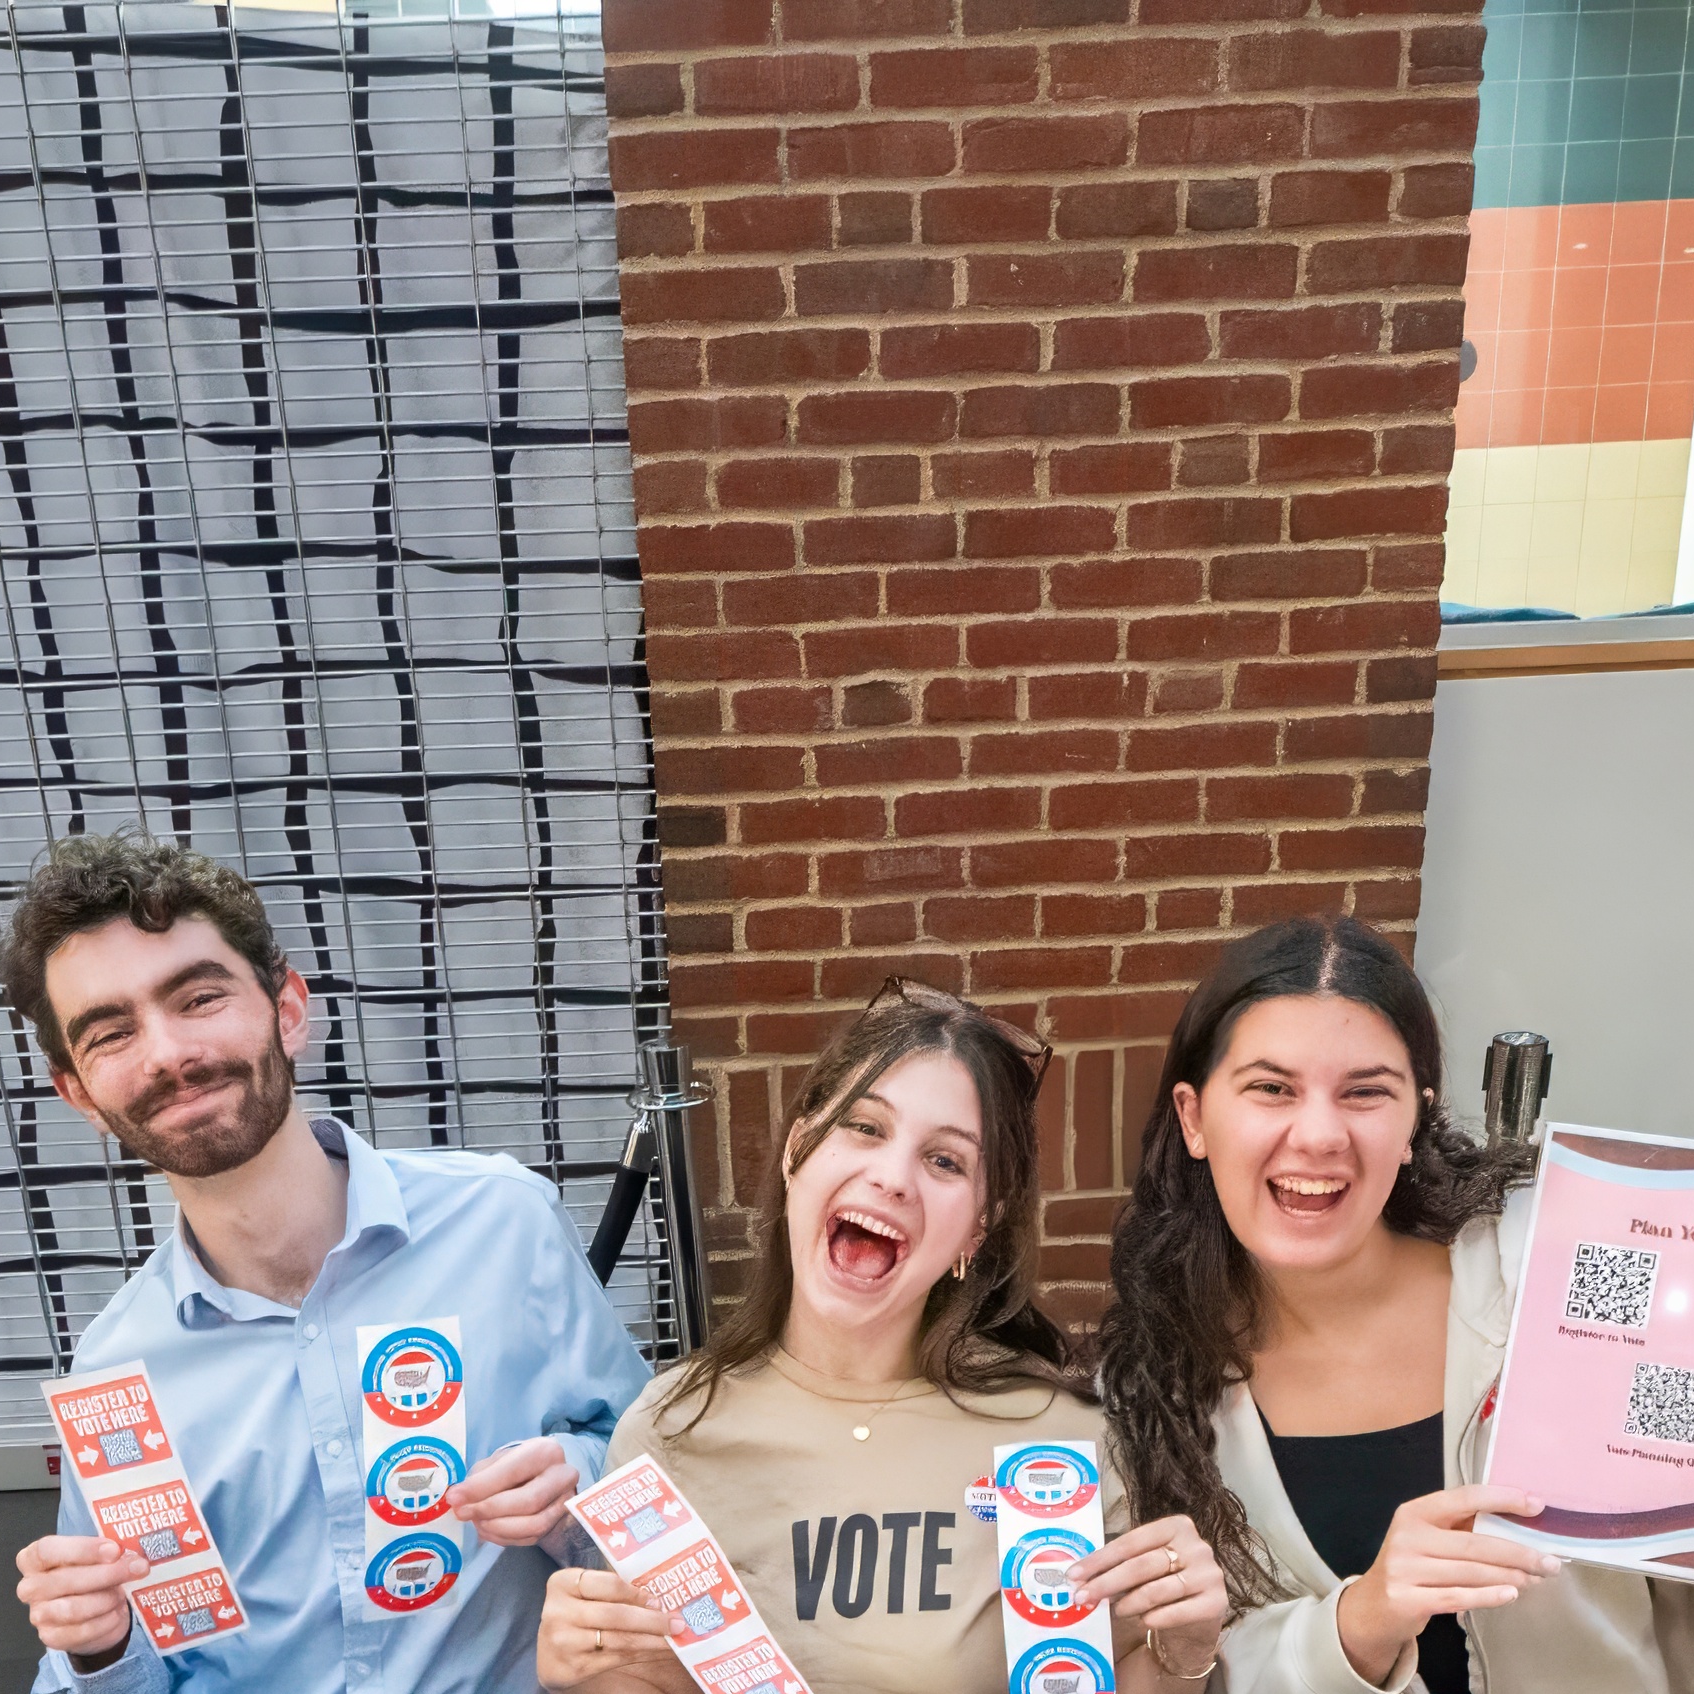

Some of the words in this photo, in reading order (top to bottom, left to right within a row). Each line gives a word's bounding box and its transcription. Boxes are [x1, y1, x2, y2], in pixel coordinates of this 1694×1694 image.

[1630, 1219, 1673, 1238] Plan
[59, 1389, 126, 1424] REGISTER
[126, 1382, 150, 1404] TO
[72, 1415, 110, 1439] VOTE
[109, 1406, 150, 1431] HERE
[100, 1496, 165, 1525] REGISTER
[165, 1488, 189, 1508] TO
[971, 1491, 997, 1504] VOT
[112, 1517, 149, 1540] VOTE
[149, 1507, 189, 1531] HERE
[791, 1511, 956, 1621] VOTE
[139, 1579, 200, 1609] REGISTER
[200, 1572, 223, 1590] TO
[153, 1598, 186, 1619] VOTE
[186, 1588, 223, 1608] HERE
